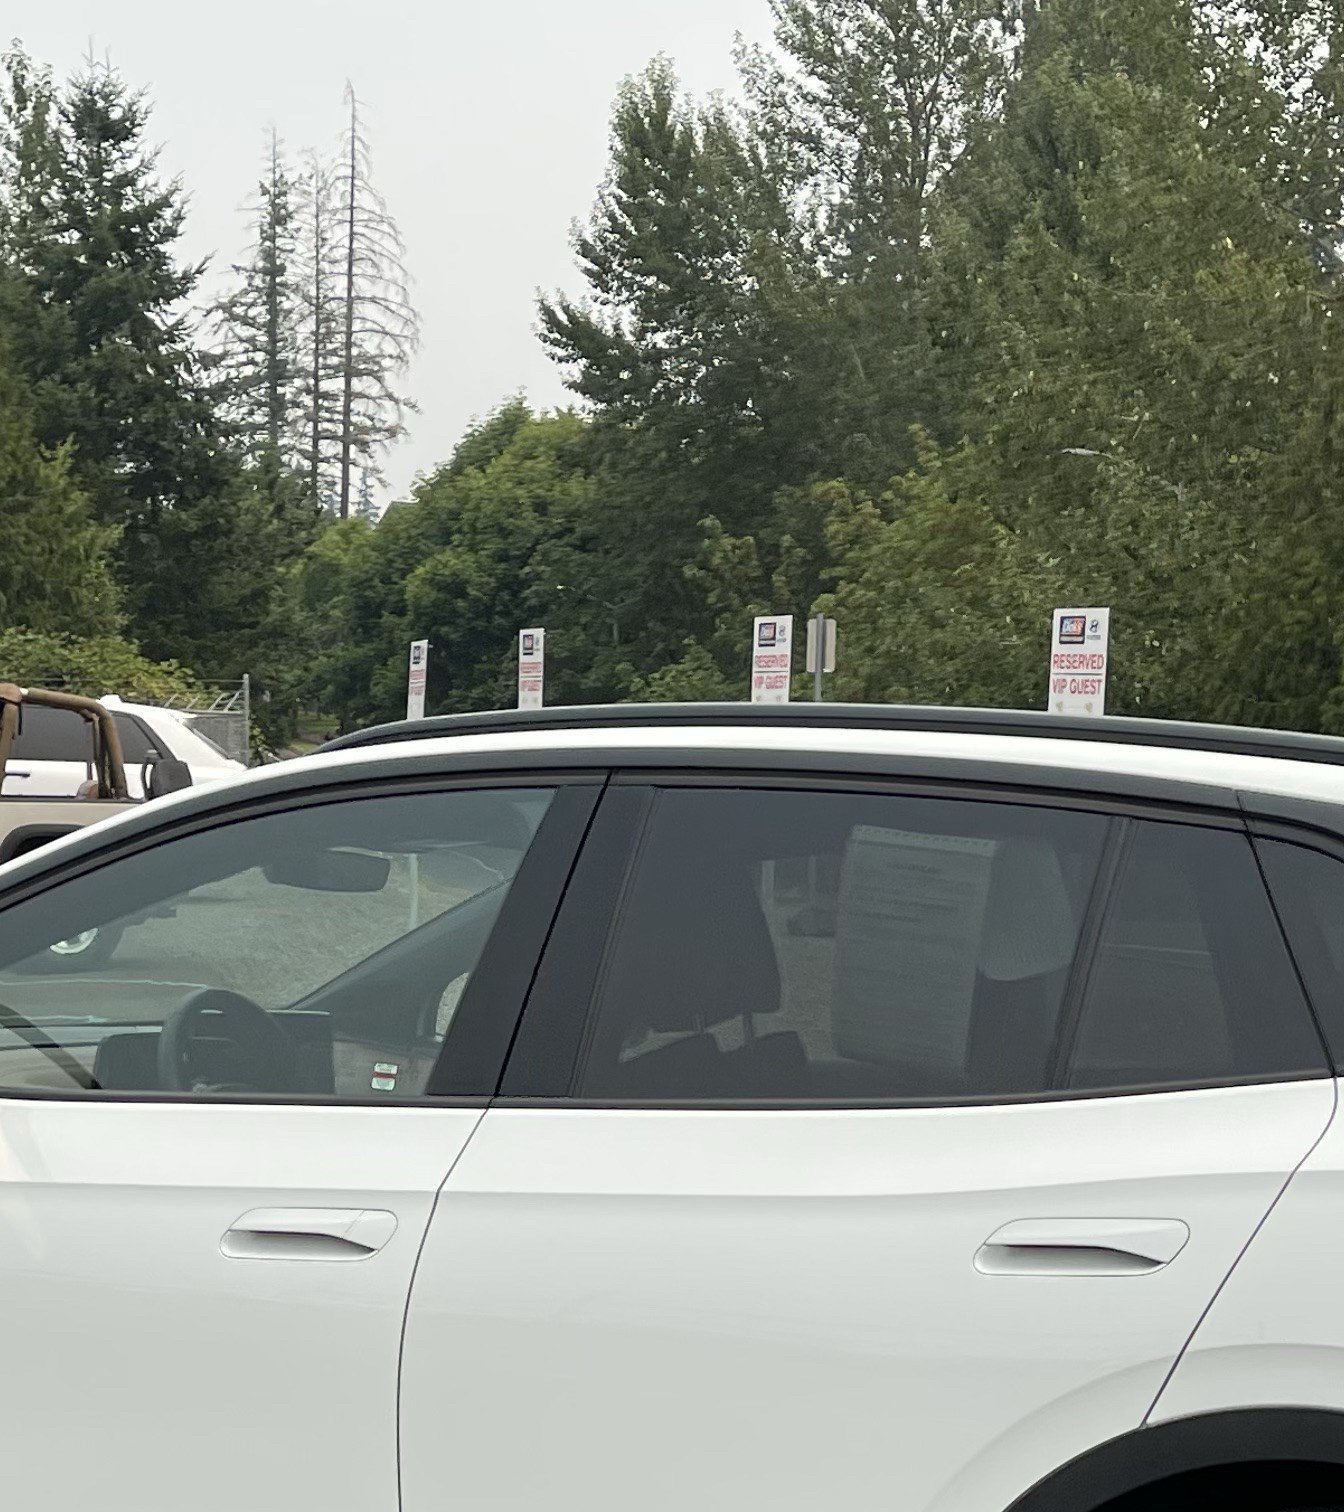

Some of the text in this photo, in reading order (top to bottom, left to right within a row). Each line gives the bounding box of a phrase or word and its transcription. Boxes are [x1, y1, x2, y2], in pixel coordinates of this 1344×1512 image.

[1052, 653, 1105, 670] RESERVED
[1052, 678, 1103, 695] VIP GUEST
